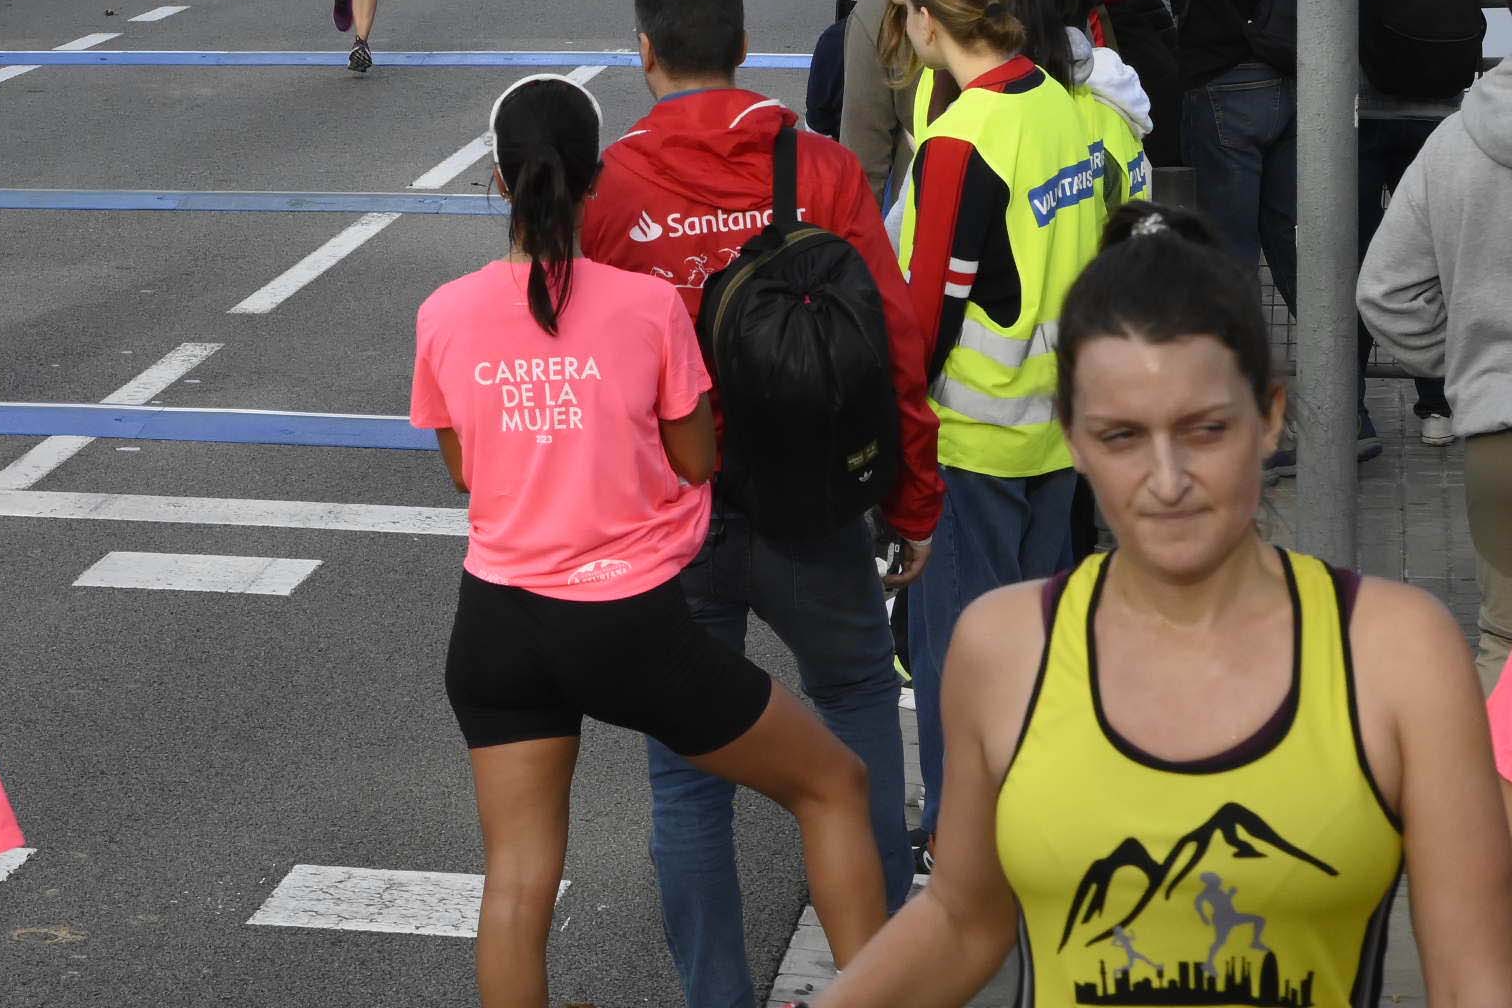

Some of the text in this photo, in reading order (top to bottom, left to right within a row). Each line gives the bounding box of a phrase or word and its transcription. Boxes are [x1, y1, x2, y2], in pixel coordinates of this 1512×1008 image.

[474, 356, 602, 386] CARRERA
[501, 382, 578, 408] DE LA
[501, 407, 584, 432] MUJER
